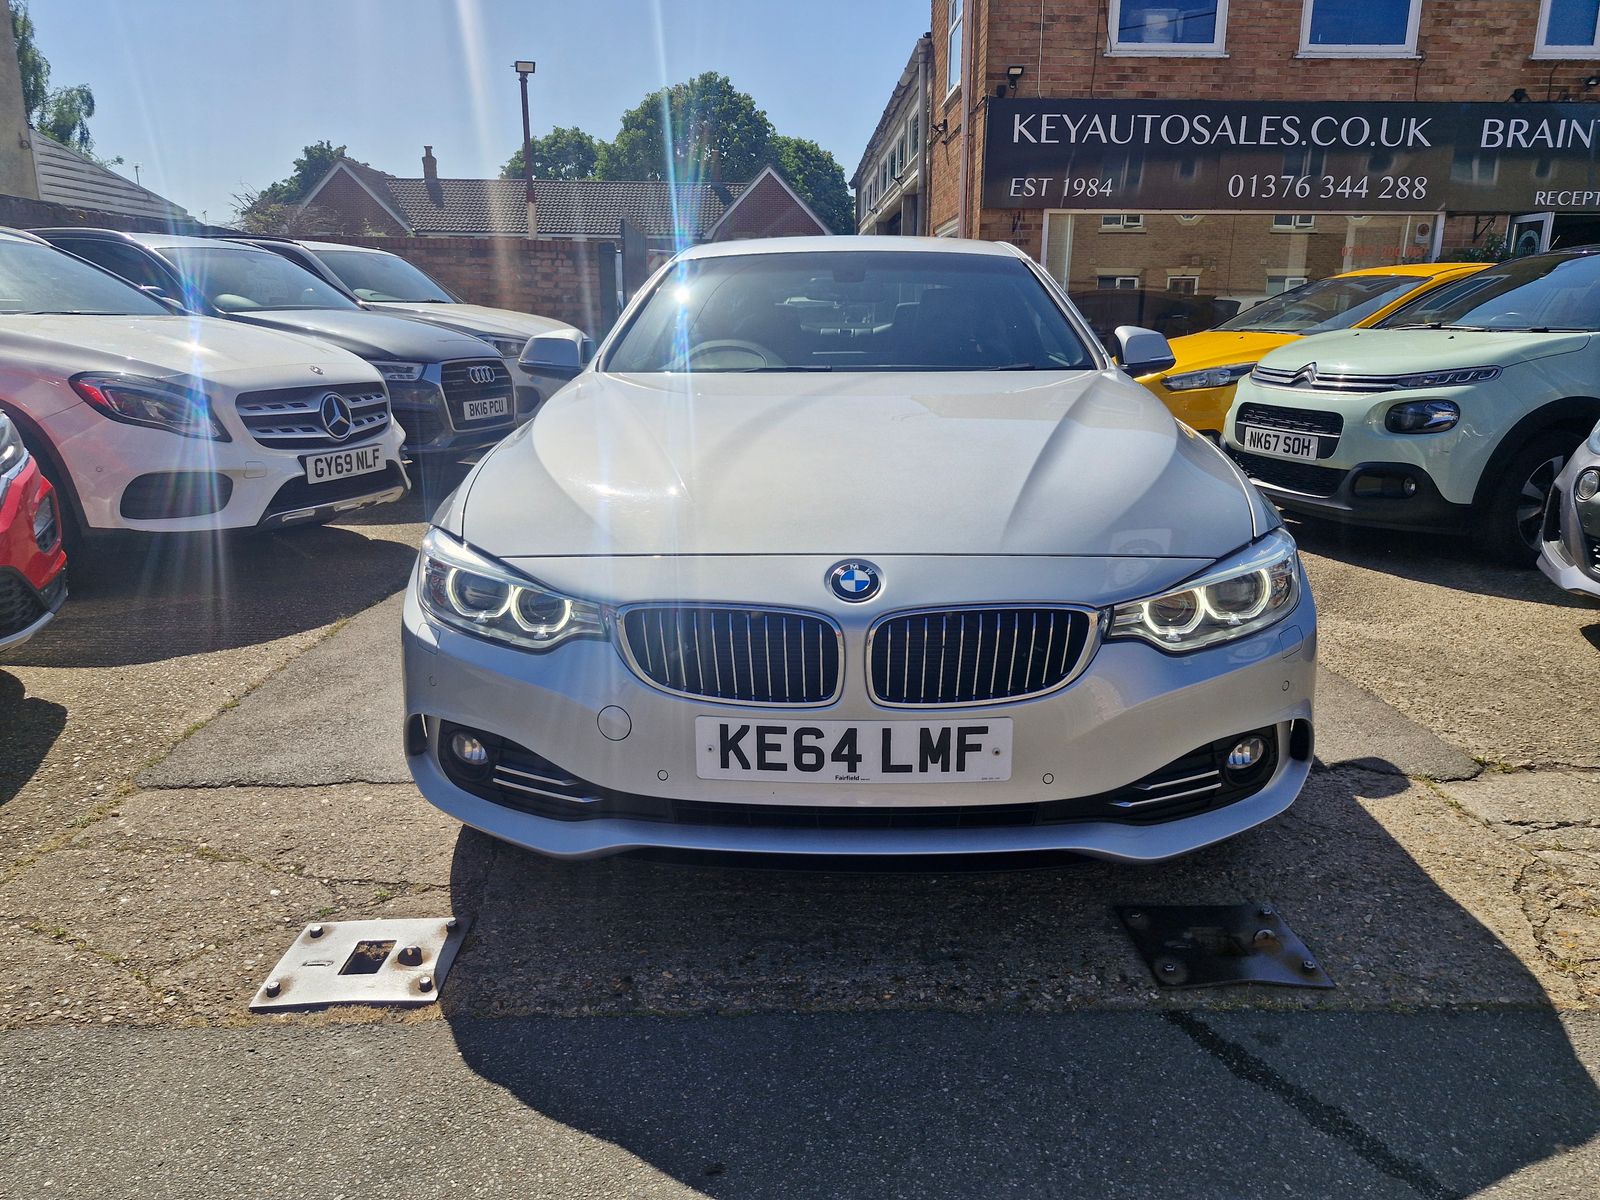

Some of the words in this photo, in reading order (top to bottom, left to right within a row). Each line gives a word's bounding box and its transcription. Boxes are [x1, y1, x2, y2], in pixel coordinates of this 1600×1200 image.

[1013, 114, 1432, 147] KEYAUTOSALES.CO.UK
[1480, 118, 1600, 148] BRAIN
[1009, 177, 1053, 197] EST
[1063, 177, 1113, 197] 1984
[1228, 174, 1312, 198] 01376
[1319, 175, 1369, 199] 344
[1378, 176, 1428, 200] 288
[468, 401, 488, 417] BK16
[489, 399, 504, 414] PCU
[1249, 431, 1280, 452] NK67
[1282, 436, 1312, 457] SOH
[314, 453, 353, 478] GY69
[356, 448, 380, 471] NLF
[835, 563, 875, 576] BMW
[719, 723, 863, 773] KE64
[881, 725, 989, 774] LMF
